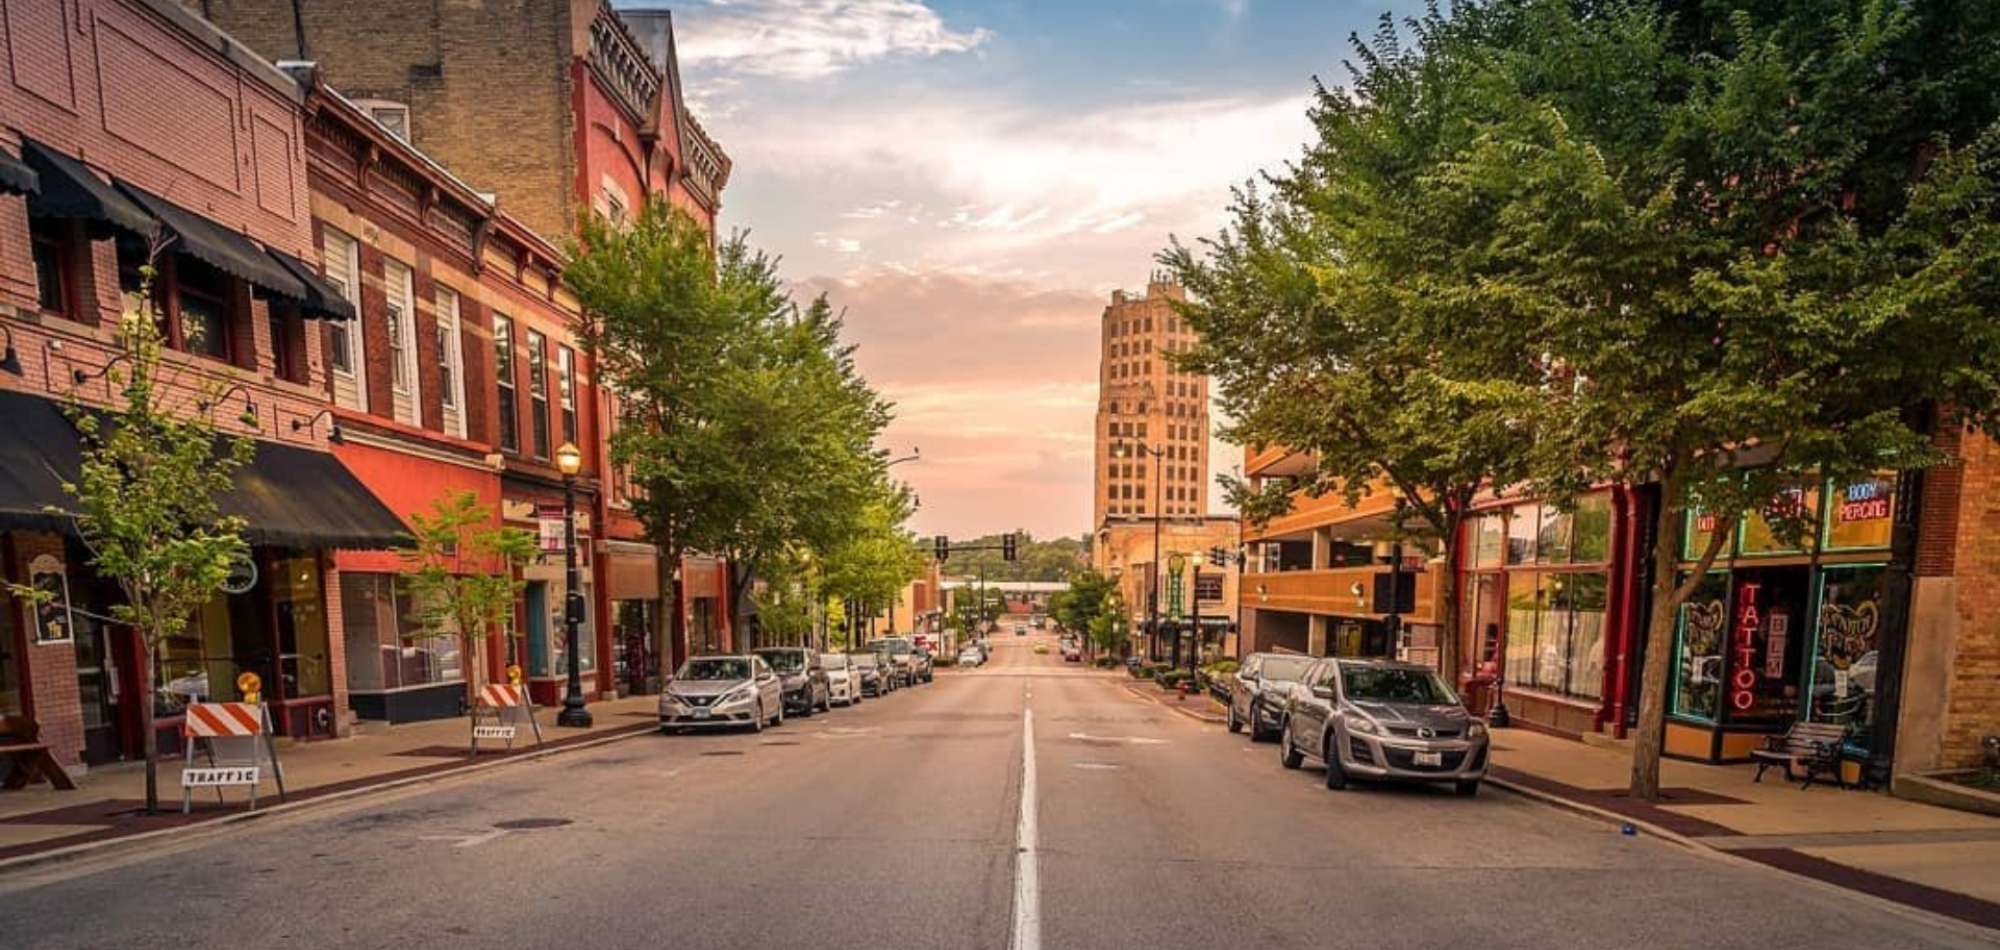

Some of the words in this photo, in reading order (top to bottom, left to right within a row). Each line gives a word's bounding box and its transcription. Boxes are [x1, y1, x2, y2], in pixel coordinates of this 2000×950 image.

[1849, 483, 1877, 501] BODY
[1839, 500, 1887, 521] PIERCING
[1735, 583, 1761, 709] TATTOO
[188, 770, 254, 783] TRAFFIC
